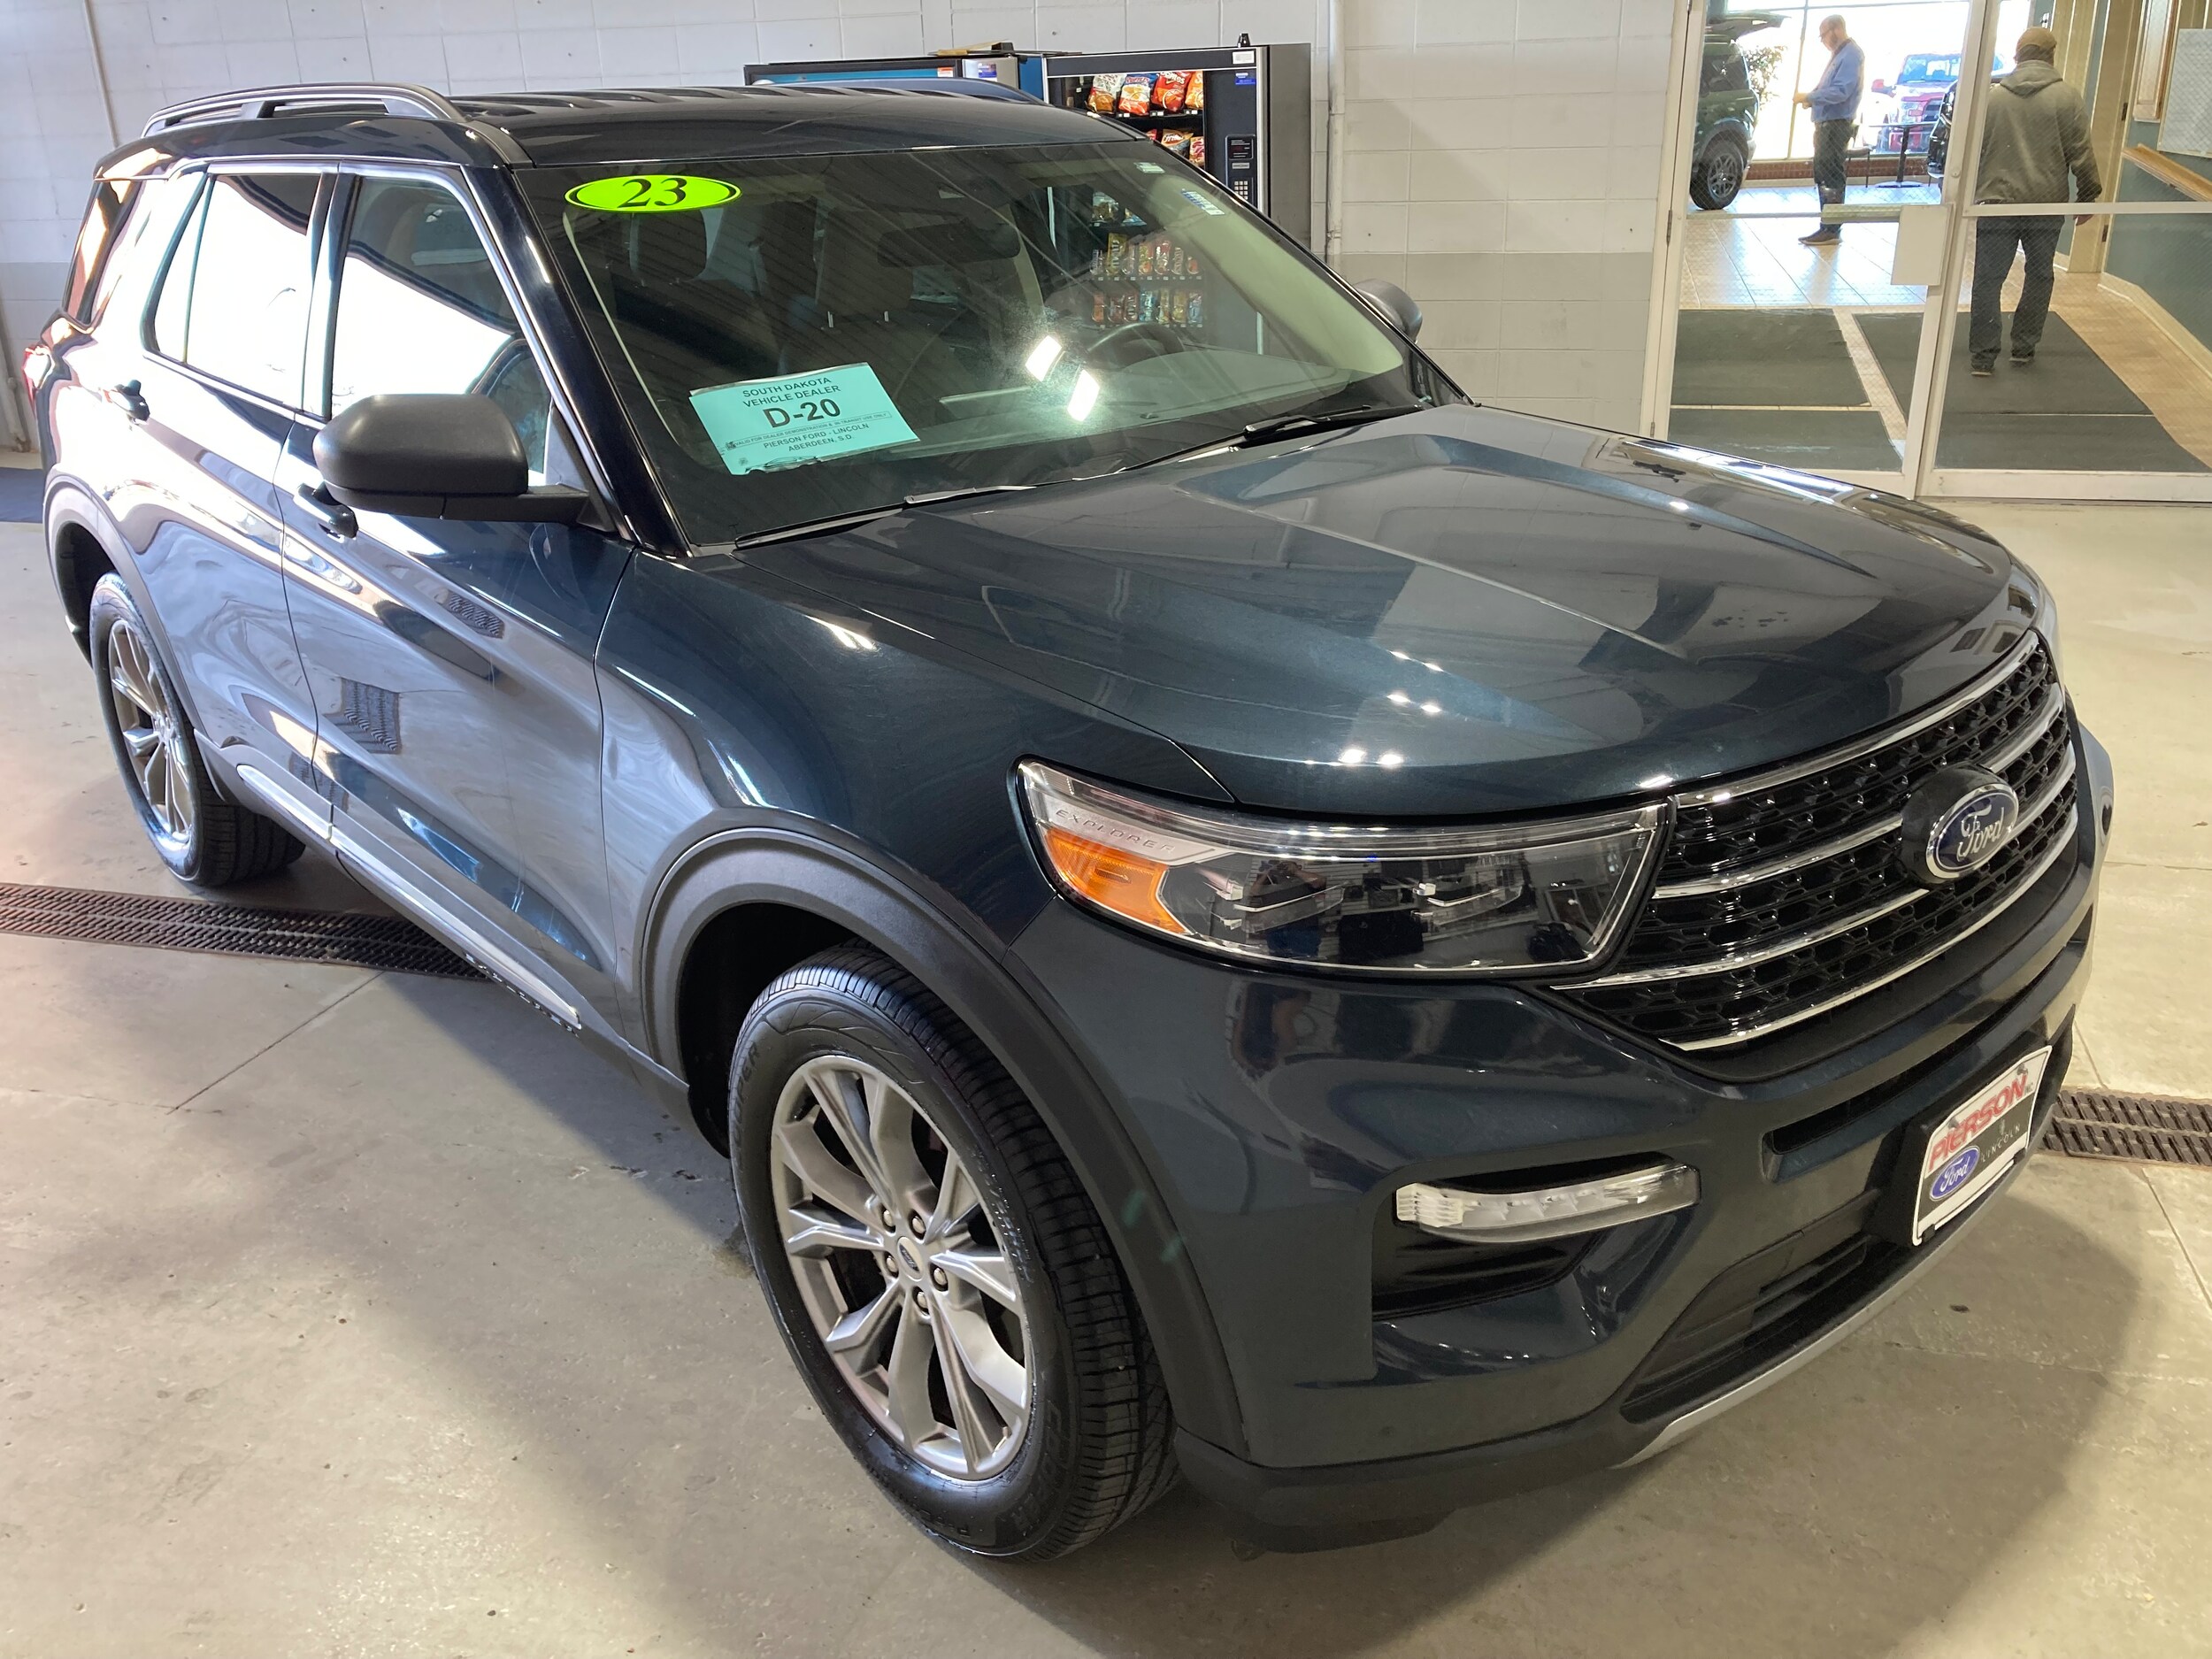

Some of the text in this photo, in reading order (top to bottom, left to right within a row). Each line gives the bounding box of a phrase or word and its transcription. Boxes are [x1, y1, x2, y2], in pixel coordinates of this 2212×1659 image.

[617, 178, 687, 208] 23
[742, 377, 832, 397] SOUTH DAKOTA
[742, 384, 841, 408] VEHICLE DEALER
[763, 398, 841, 428] D-20
[764, 436, 802, 449] PIERSON
[803, 431, 827, 441] FORD
[833, 423, 870, 434] LINCOLN
[788, 437, 837, 452] ABERDEEN,
[1056, 809, 1176, 855] EXPLORER
[1955, 803, 2005, 863] Ford
[1929, 1074, 2028, 1172] PIERSON
[1980, 1123, 2021, 1164] LINCOLN
[1939, 1156, 1970, 1193] Ford
